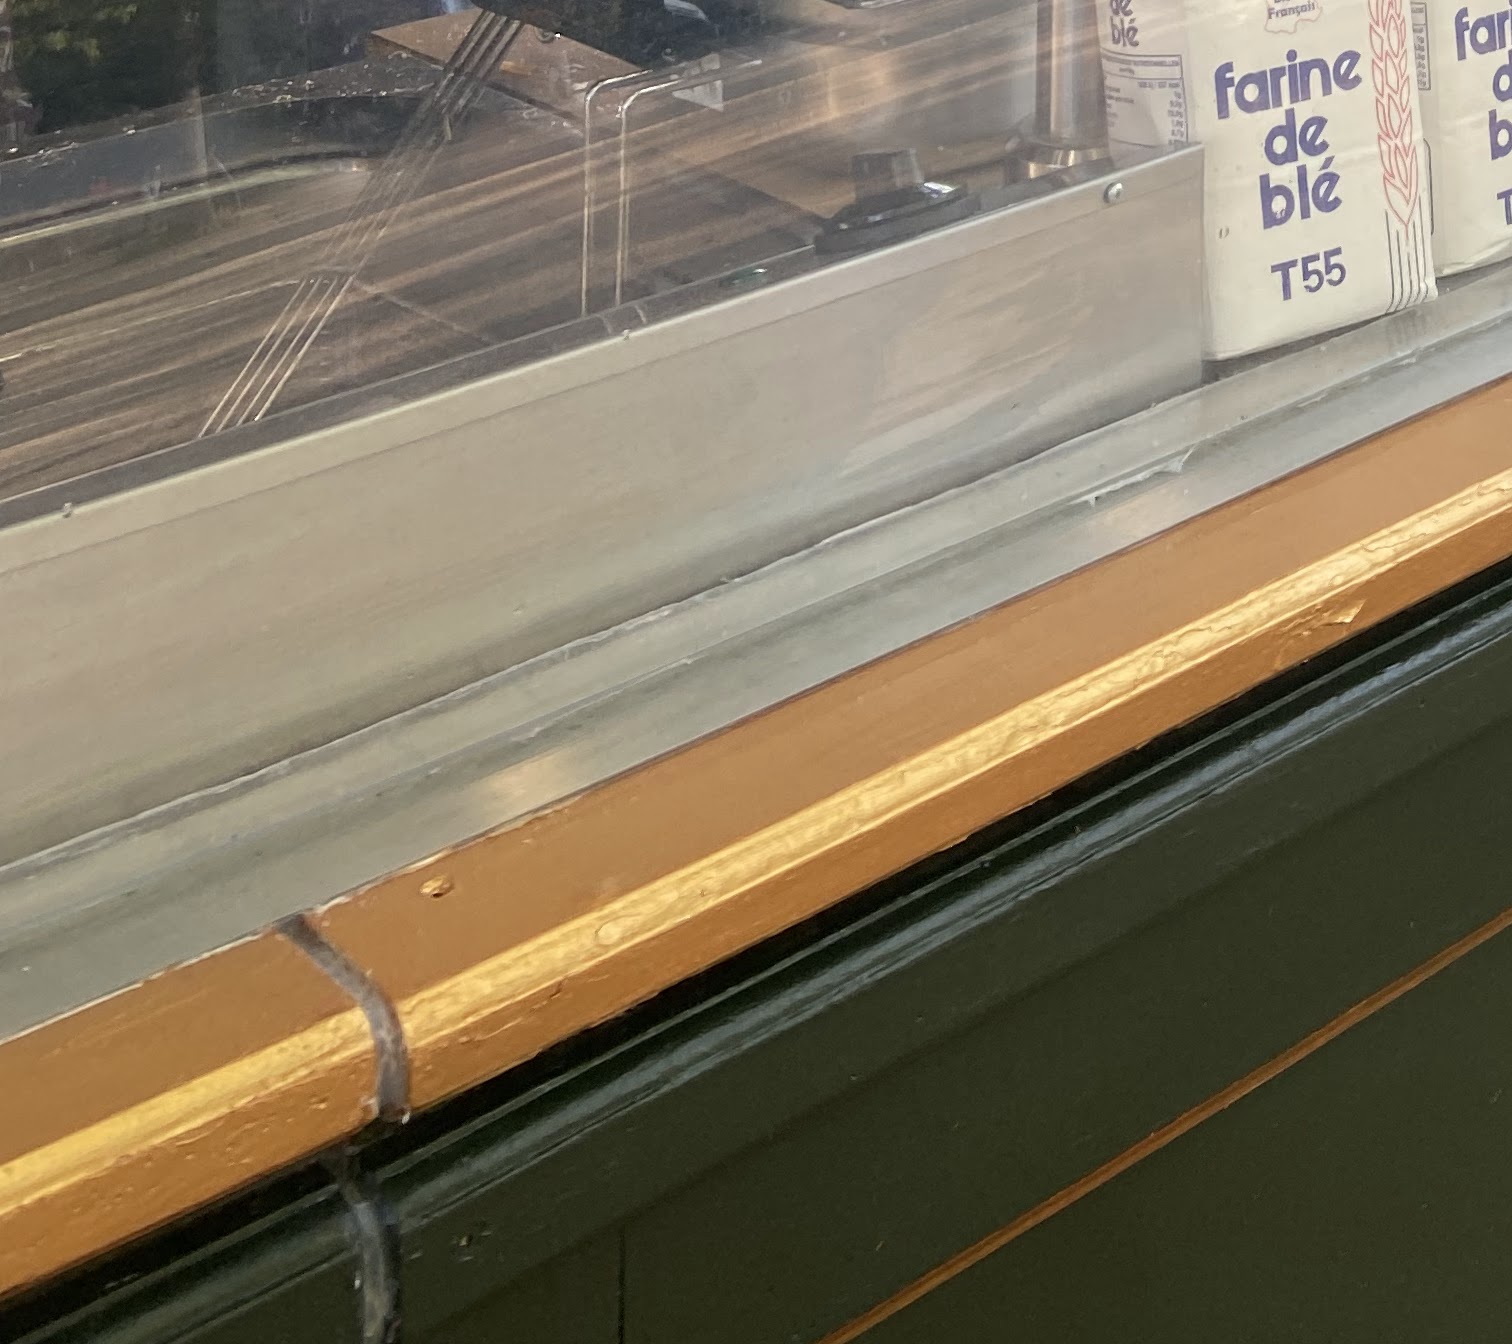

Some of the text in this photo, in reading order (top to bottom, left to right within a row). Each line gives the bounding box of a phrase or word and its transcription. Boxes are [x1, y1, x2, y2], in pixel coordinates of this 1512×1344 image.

[1110, 15, 1140, 47] blé
[1267, 0, 1316, 20] Français
[1214, 49, 1363, 120] farine
[1264, 107, 1330, 166] de
[1259, 155, 1343, 230] blé
[1270, 246, 1347, 301] T55
